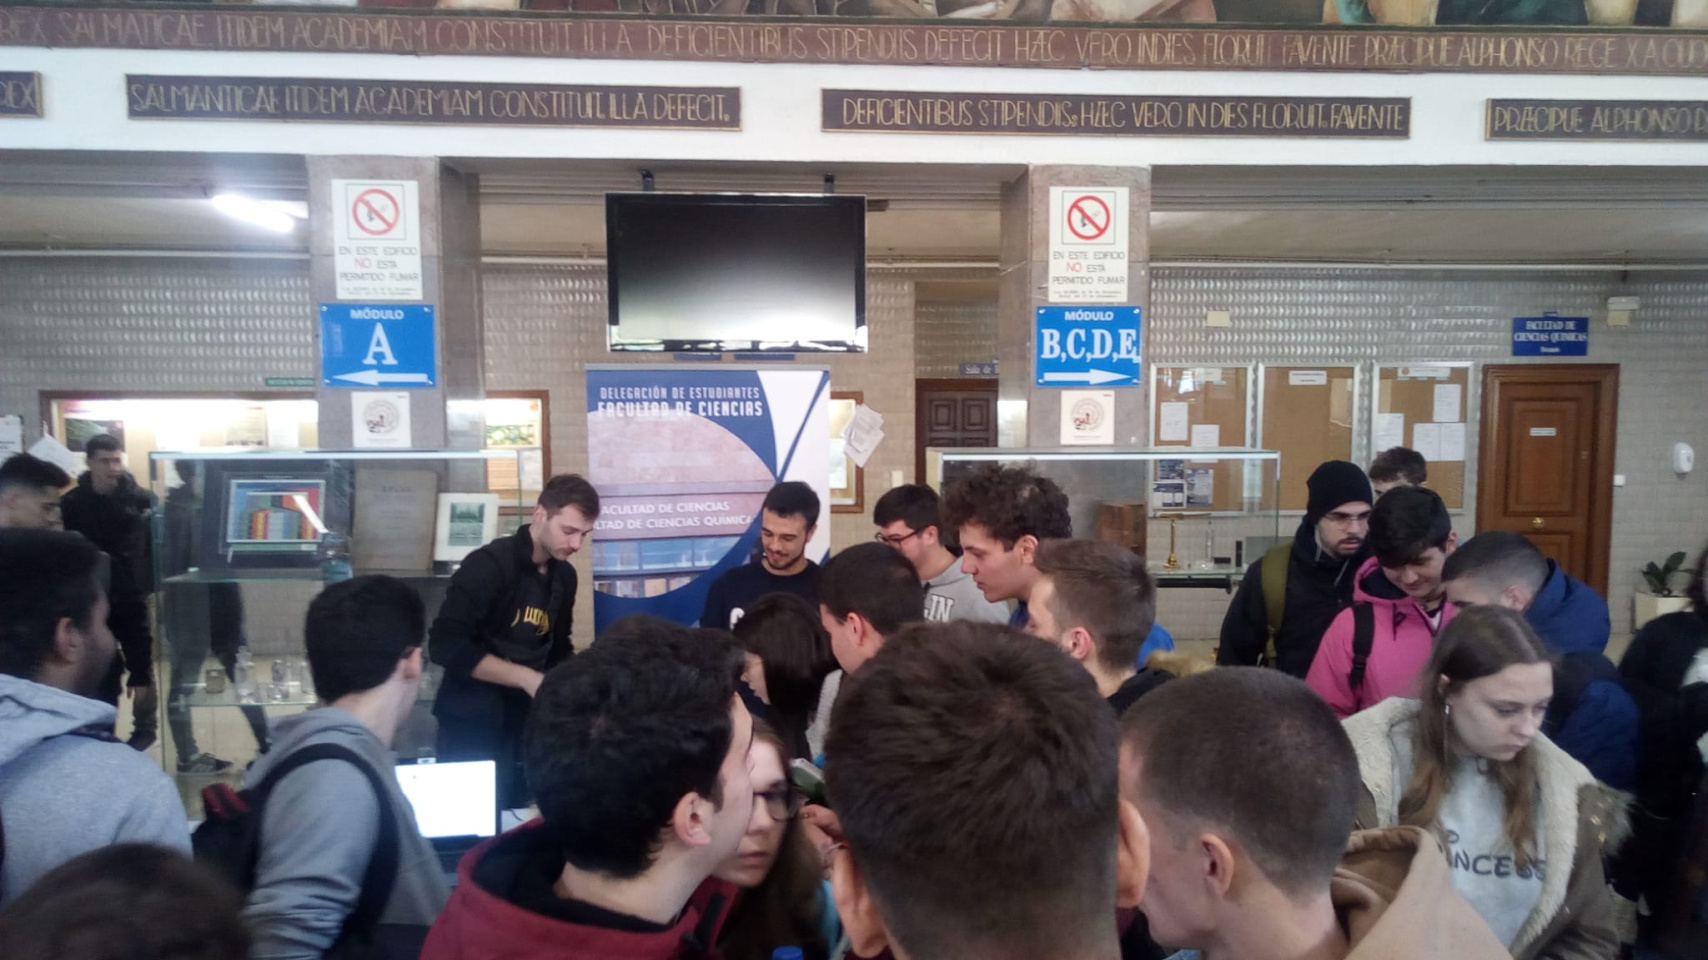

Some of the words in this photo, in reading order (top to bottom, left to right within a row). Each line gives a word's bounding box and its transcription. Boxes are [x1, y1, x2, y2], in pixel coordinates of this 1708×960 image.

[292, 17, 428, 51] ACADEMIAM
[925, 28, 1007, 62] DEFECIT
[842, 97, 974, 126] DEFICIENTIBUS
[1131, 101, 1183, 129] VERO
[1330, 103, 1405, 131] FAVENTE
[1590, 106, 1692, 134] ALPHONSO
[356, 246, 379, 256] ESTE
[1053, 251, 1065, 260] EN
[1068, 251, 1089, 260] ESTE
[354, 258, 372, 269] NO
[1066, 262, 1083, 273] NO
[1052, 276, 1094, 285] PERMITIDO
[1097, 276, 1125, 285] FUMAR
[350, 307, 405, 320] MÓDULO
[1064, 309, 1115, 321] MÓDULO
[361, 321, 399, 365] A
[600, 385, 667, 400] DELEGACIÓN
[671, 387, 686, 400] DE
[689, 387, 760, 400] ESTUDIANTES
[597, 402, 669, 418] FACULTAD
[675, 402, 693, 417] DE
[697, 401, 764, 417] CIENCIAS
[658, 502, 674, 514] DE
[676, 500, 731, 513] CIENCIAS
[627, 517, 642, 530] DE
[646, 515, 701, 529] CIENCIAS
